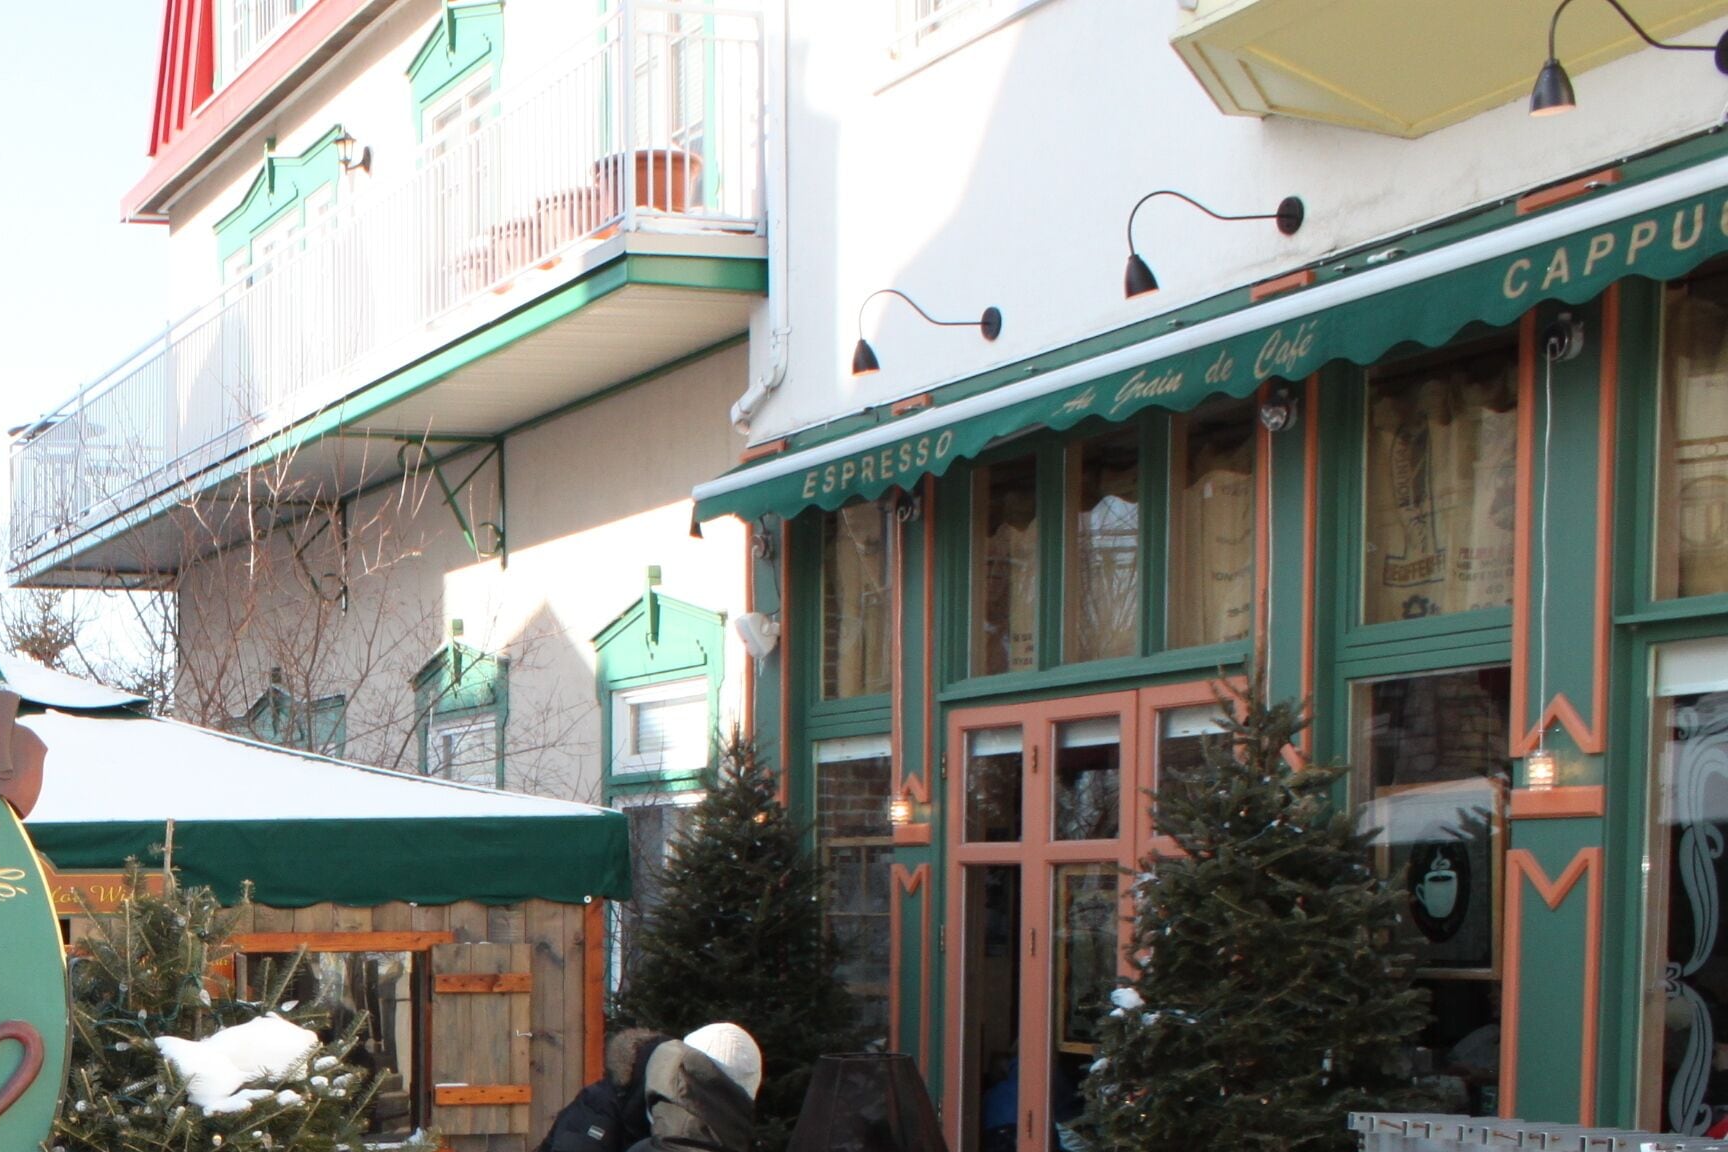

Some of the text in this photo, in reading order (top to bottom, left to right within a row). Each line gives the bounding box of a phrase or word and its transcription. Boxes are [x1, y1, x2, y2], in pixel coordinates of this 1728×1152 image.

[1109, 369, 1184, 415] Grain
[1205, 351, 1234, 384] de
[1253, 320, 1318, 379] Café
[802, 430, 954, 499] ESPRESSO
